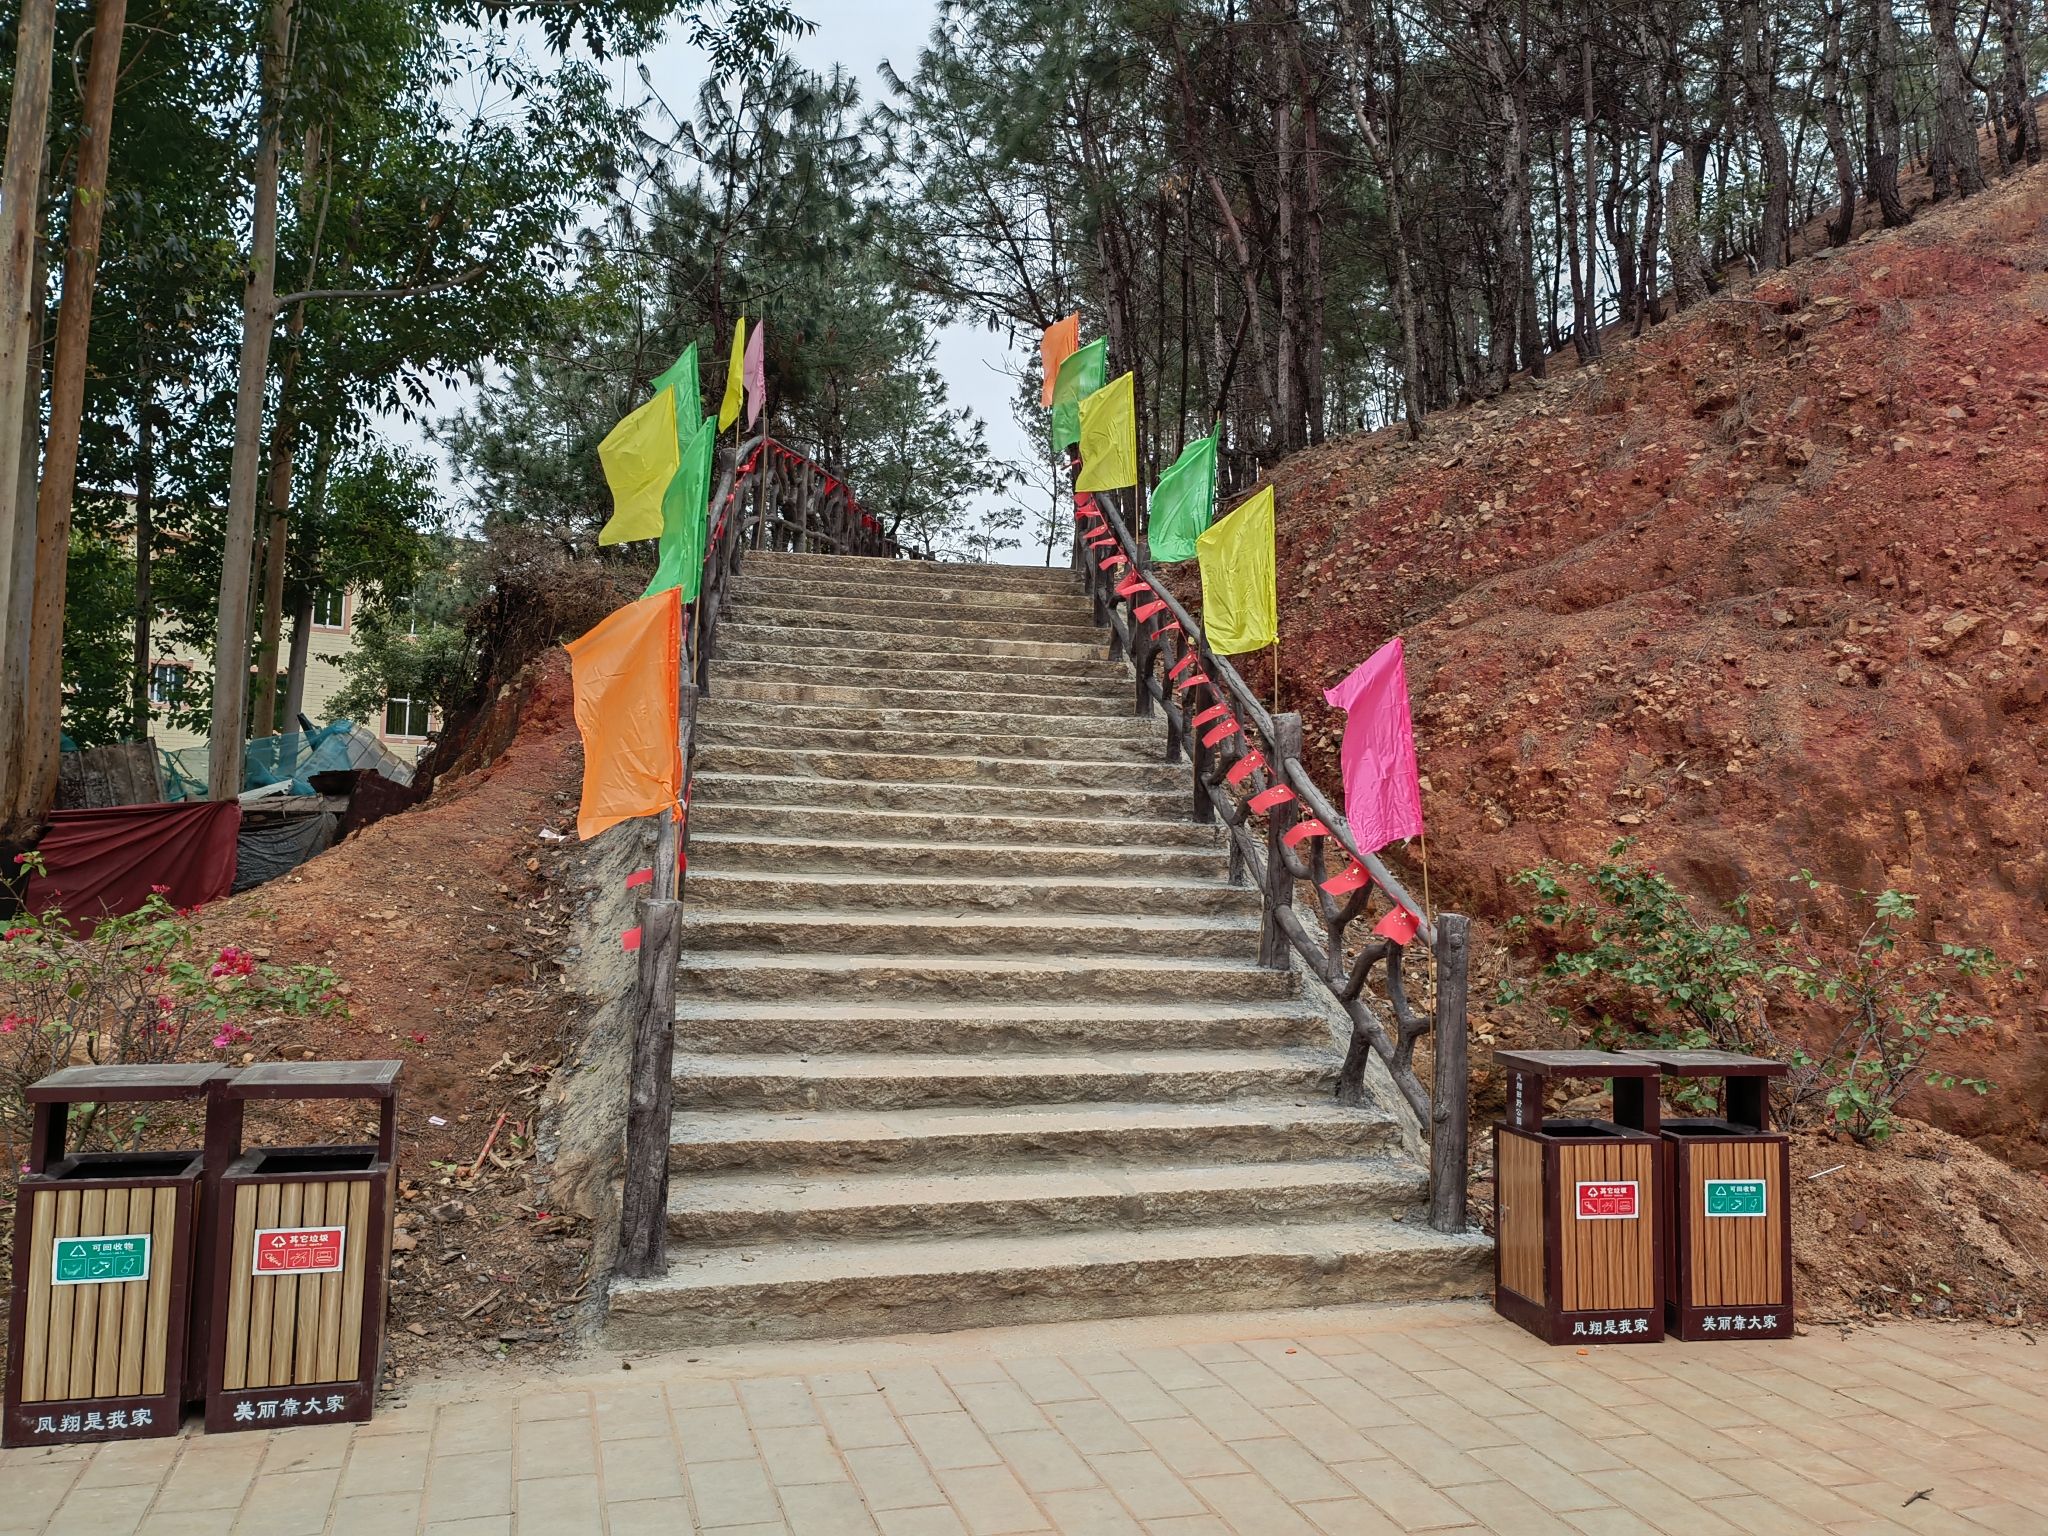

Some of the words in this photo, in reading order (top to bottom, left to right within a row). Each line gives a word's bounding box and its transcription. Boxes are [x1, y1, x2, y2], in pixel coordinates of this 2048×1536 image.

[91, 1242, 135, 1252] 可回收物
[1572, 1318, 1649, 1336] 凤翔是我家
[1702, 1315, 1777, 1332] 美丽靠大家
[233, 1394, 345, 1422] 美丽靠大家
[33, 1407, 153, 1434] 凤翔是我家
